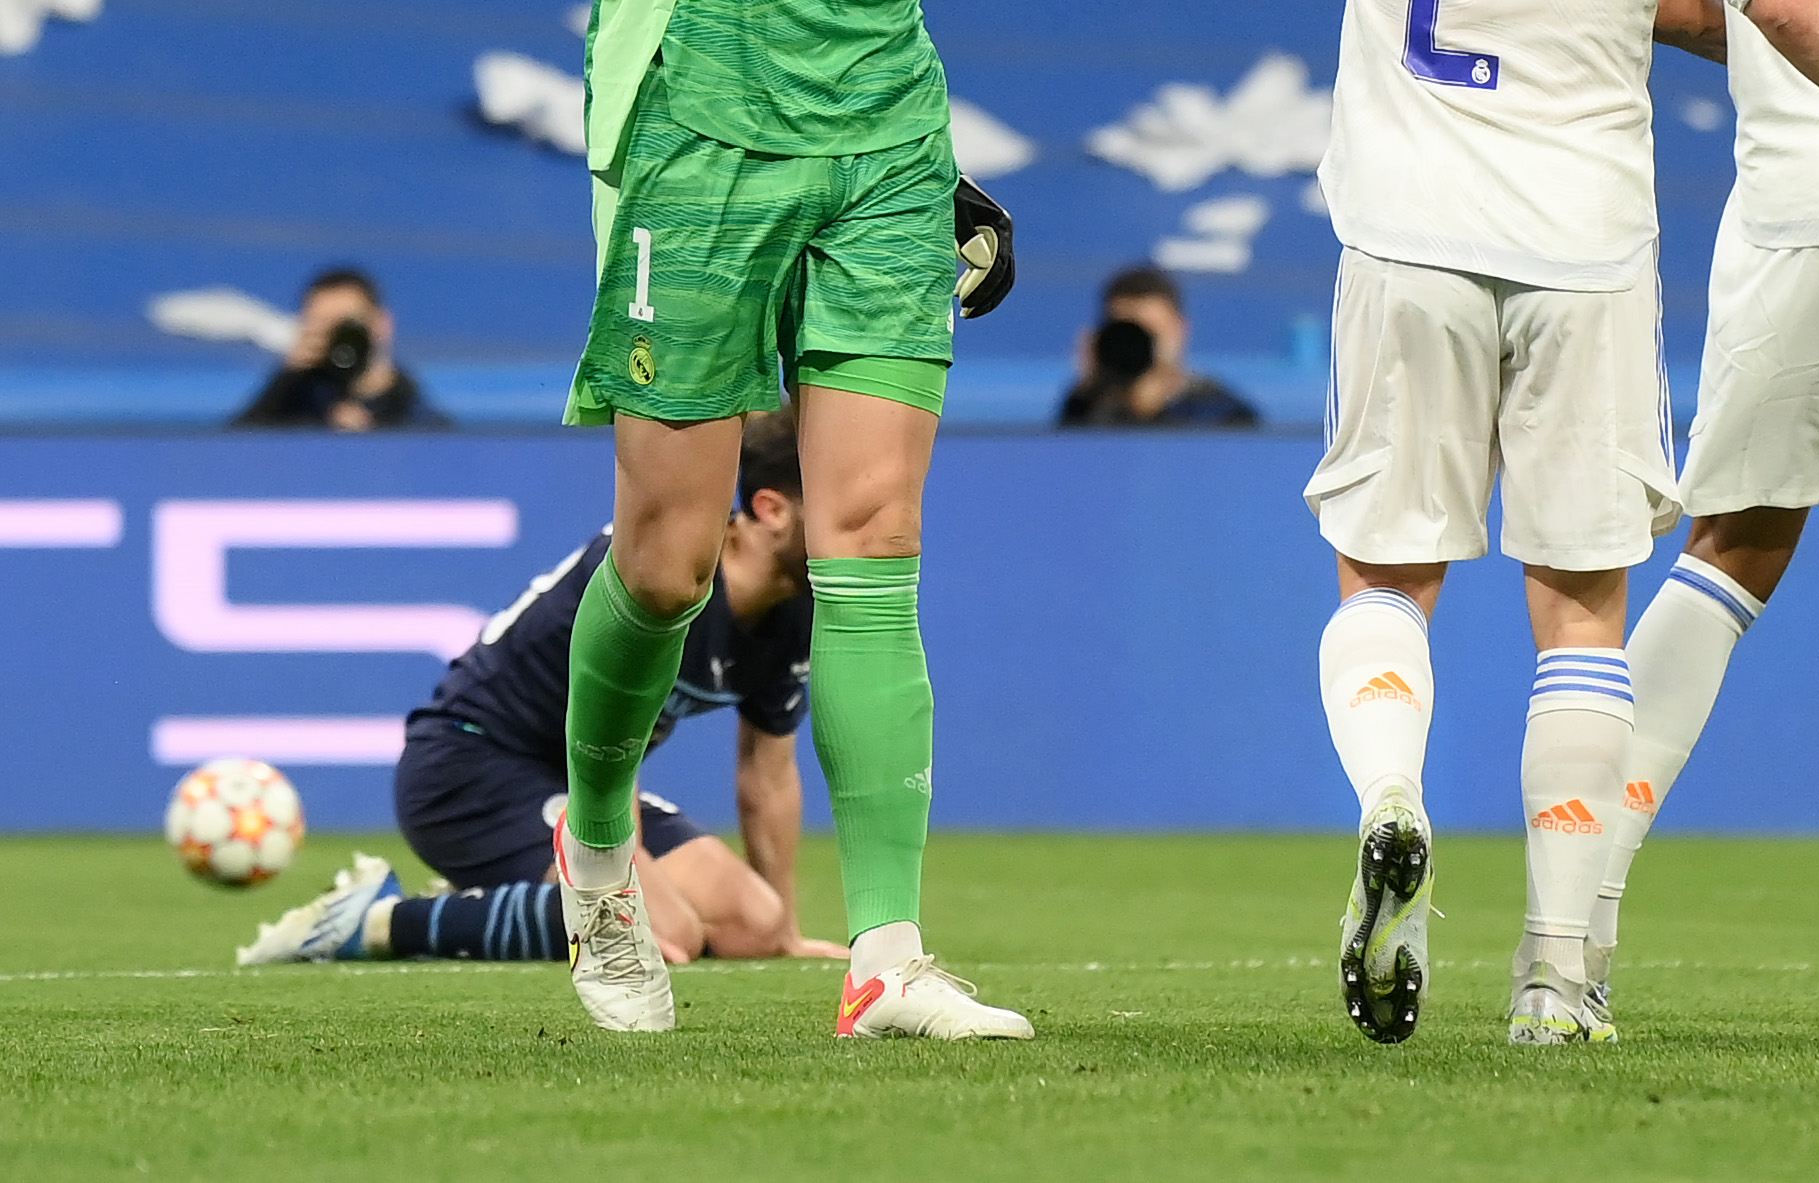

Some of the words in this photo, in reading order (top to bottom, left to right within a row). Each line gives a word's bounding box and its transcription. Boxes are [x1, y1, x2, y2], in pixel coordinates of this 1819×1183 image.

[629, 227, 655, 323] 1
[1350, 688, 1423, 712] adidas
[1531, 816, 1603, 835] adidas
